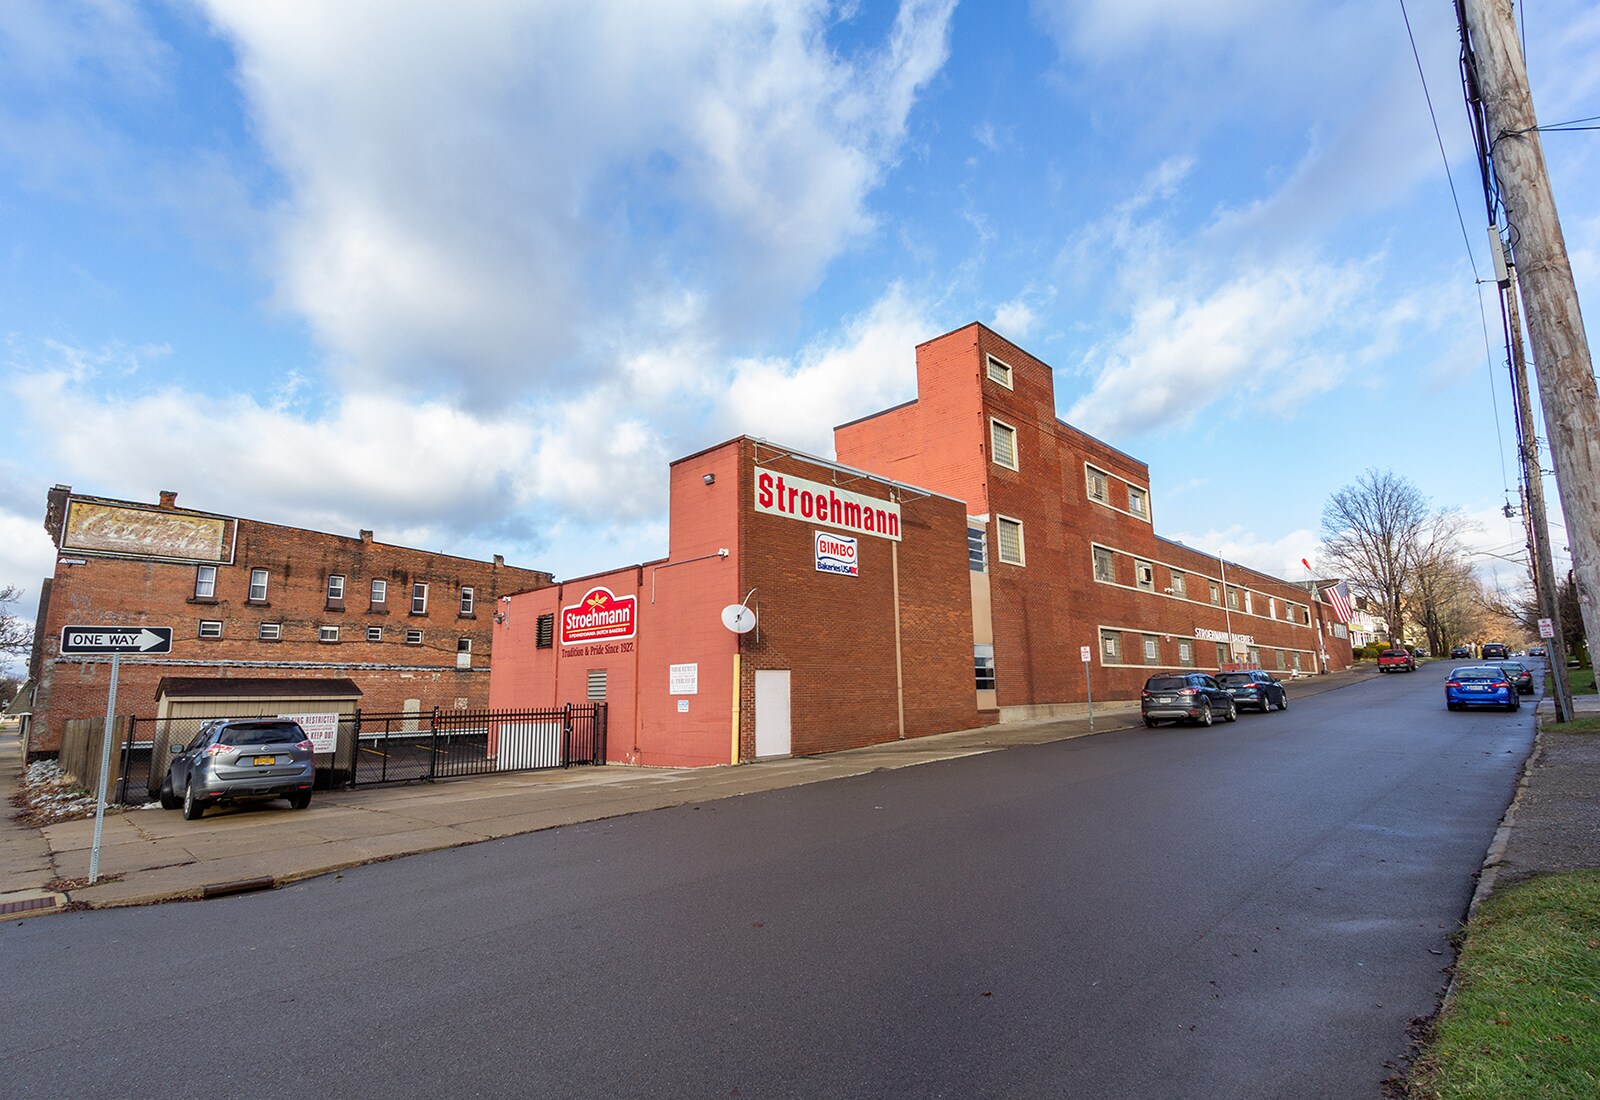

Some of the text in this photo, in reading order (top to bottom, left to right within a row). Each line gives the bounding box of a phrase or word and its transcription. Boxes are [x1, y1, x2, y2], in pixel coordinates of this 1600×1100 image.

[759, 473, 898, 536] Stroehmann
[820, 540, 854, 558] BIMBO
[817, 561, 853, 574] Bakeries USA
[566, 608, 630, 630] Stroehmann
[73, 634, 139, 645] ONE WAY
[562, 647, 584, 658] Tradition
[585, 646, 590, 656] &
[590, 644, 604, 656] Pride
[605, 643, 619, 655] Since
[305, 716, 335, 724] RESTRICTED
